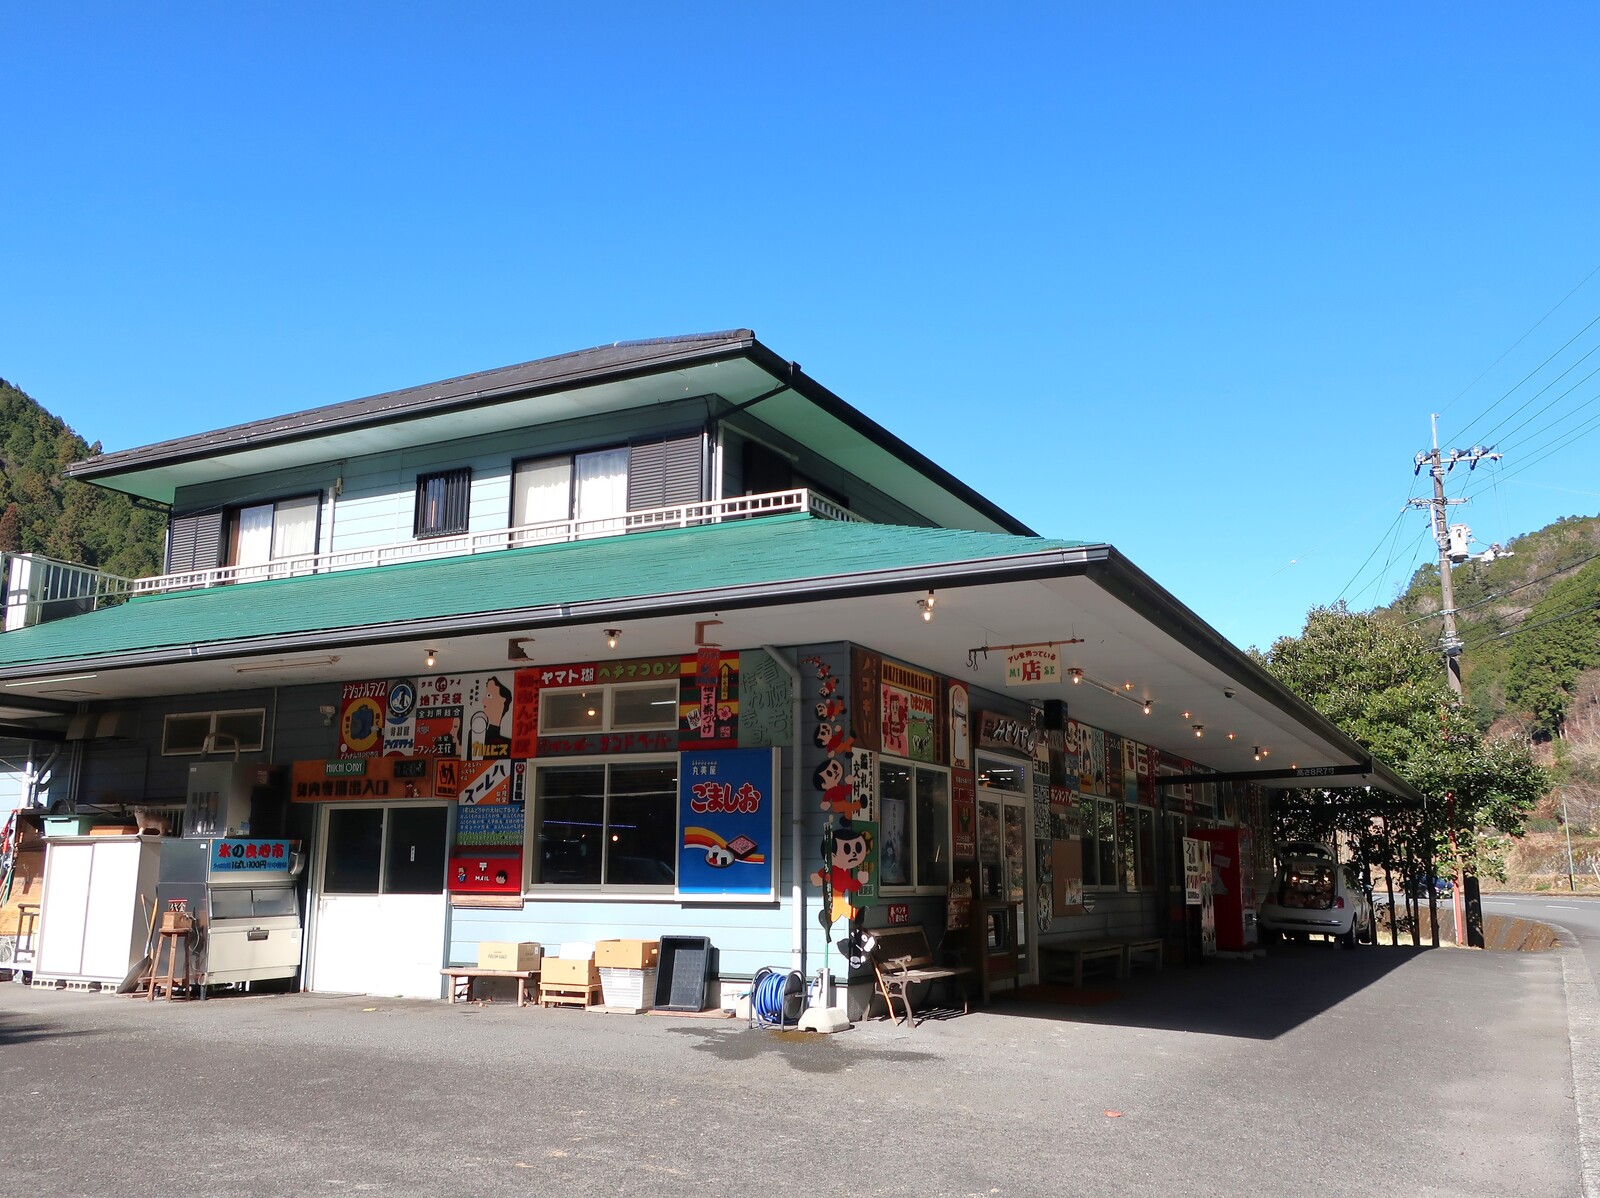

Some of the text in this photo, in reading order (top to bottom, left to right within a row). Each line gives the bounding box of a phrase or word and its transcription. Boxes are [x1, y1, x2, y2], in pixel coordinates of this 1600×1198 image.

[597, 663, 677, 679] ヘチマコロン
[1020, 658, 1040, 682] 店
[420, 693, 462, 706] 地下足袋
[692, 765, 716, 776] 丸美屋
[1296, 768, 1335, 777] 高さ8尺7寸
[691, 782, 761, 814] ごましお
[219, 843, 284, 858] 氷の良心市
